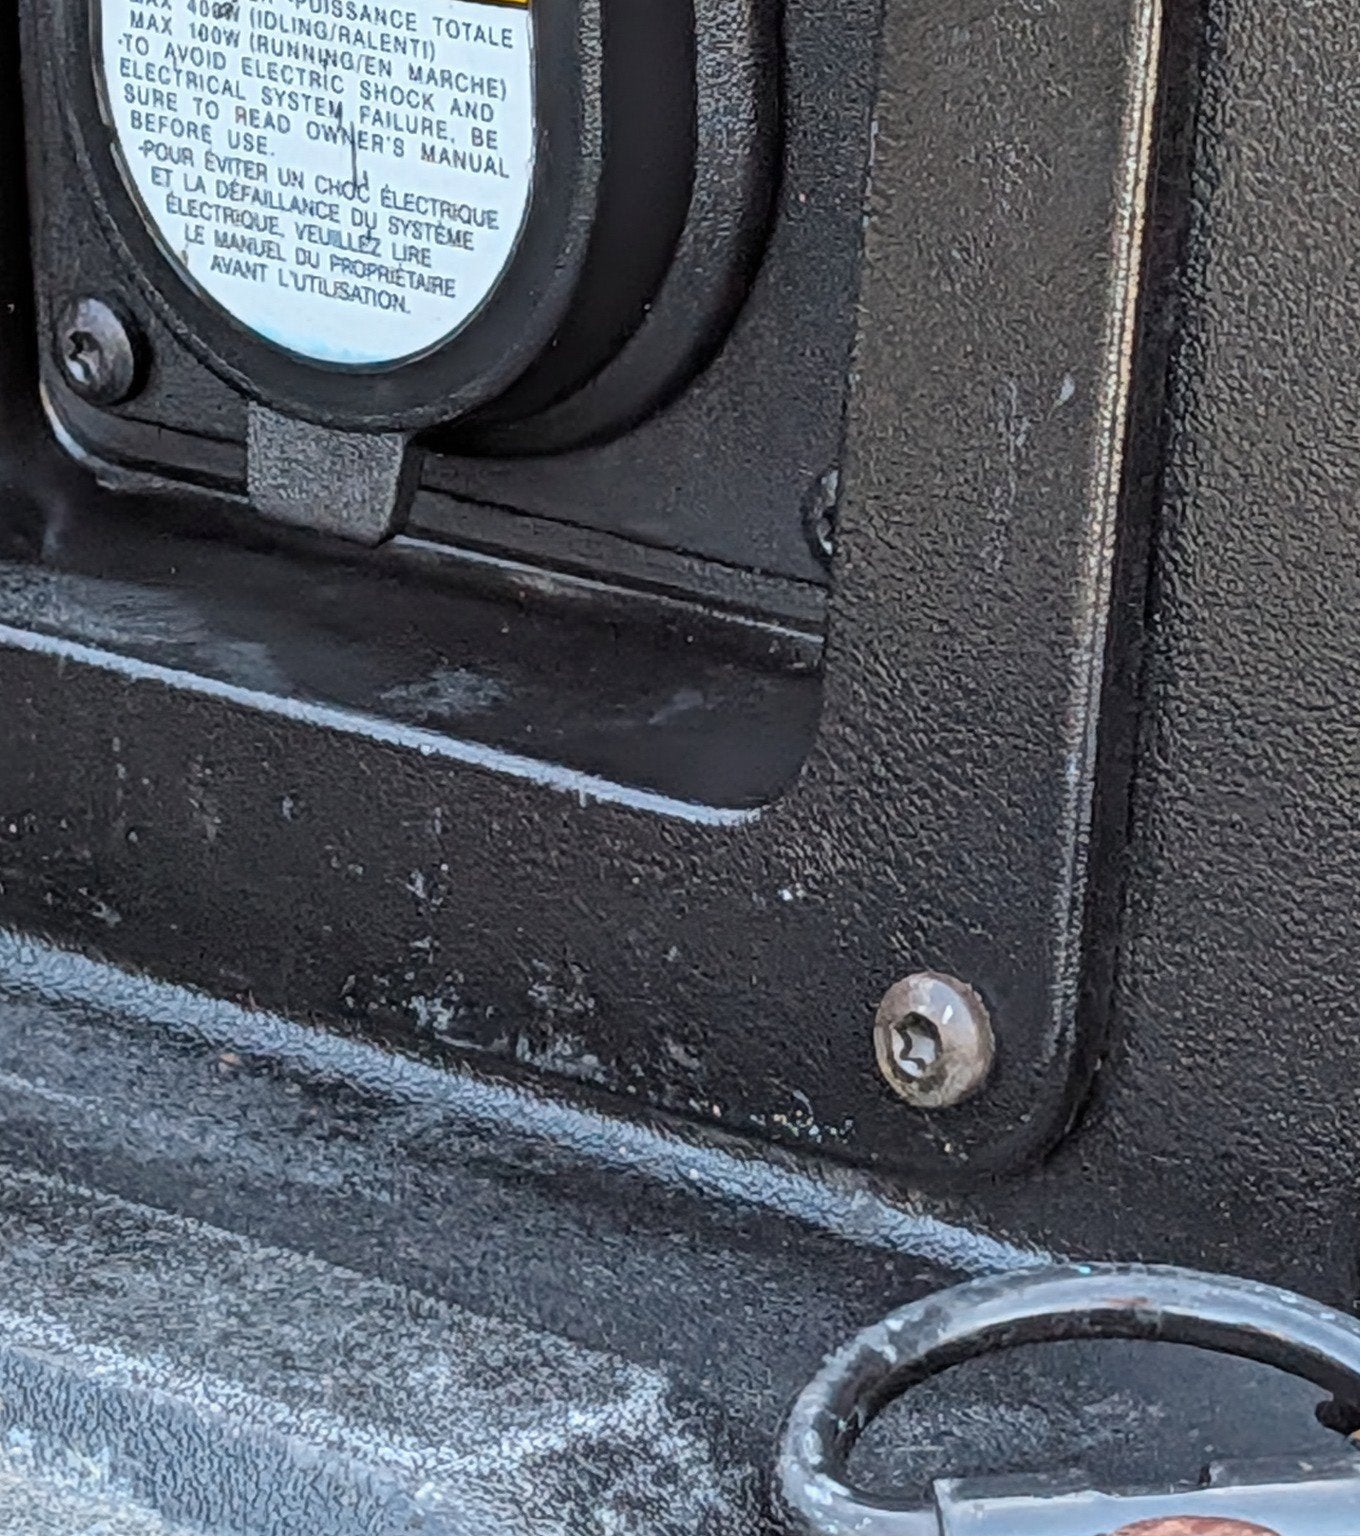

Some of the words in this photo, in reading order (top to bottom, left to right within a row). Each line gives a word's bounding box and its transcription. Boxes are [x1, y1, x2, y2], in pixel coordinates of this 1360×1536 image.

[130, 10, 172, 36] MAX
[190, 22, 240, 48] 100W
[250, 32, 391, 78] (RUNNING/EN
[408, 63, 506, 102] MARCHE)
[250, 7, 435, 62] (IDLING/RALENTI)
[433, 16, 513, 48] TOTALE
[120, 57, 246, 100] ELECTRICAL
[261, 86, 343, 119] SYSTEM
[471, 127, 498, 149] BE
[165, 42, 226, 70] AVOID
[241, 57, 344, 94] ELECTRIC
[359, 80, 434, 112] SHOCK
[450, 98, 494, 122] AND
[124, 83, 178, 112] SURE
[193, 97, 219, 120] TO
[235, 106, 290, 134] READ
[306, 120, 404, 158] OWNER'S
[421, 142, 510, 179] MANUAL
[131, 110, 212, 144] BEFORE
[228, 129, 275, 156] USE.
[151, 166, 173, 188] ET
[184, 173, 206, 194] LA
[216, 178, 340, 223] DÉFAILLANCE
[352, 207, 377, 230] DU
[205, 146, 268, 182] ÉVITER
[278, 167, 304, 190] UN
[315, 175, 370, 203] CHOC
[380, 184, 499, 230] ÉLECTRIQUE
[184, 223, 205, 244] LE
[214, 229, 286, 262] MANUEL
[295, 247, 320, 269] DU
[330, 254, 455, 298] PROPRIÉTAIRE
[210, 255, 268, 282] AVANT
[295, 222, 381, 257] VEUILLEZ
[392, 242, 431, 268] LIRE
